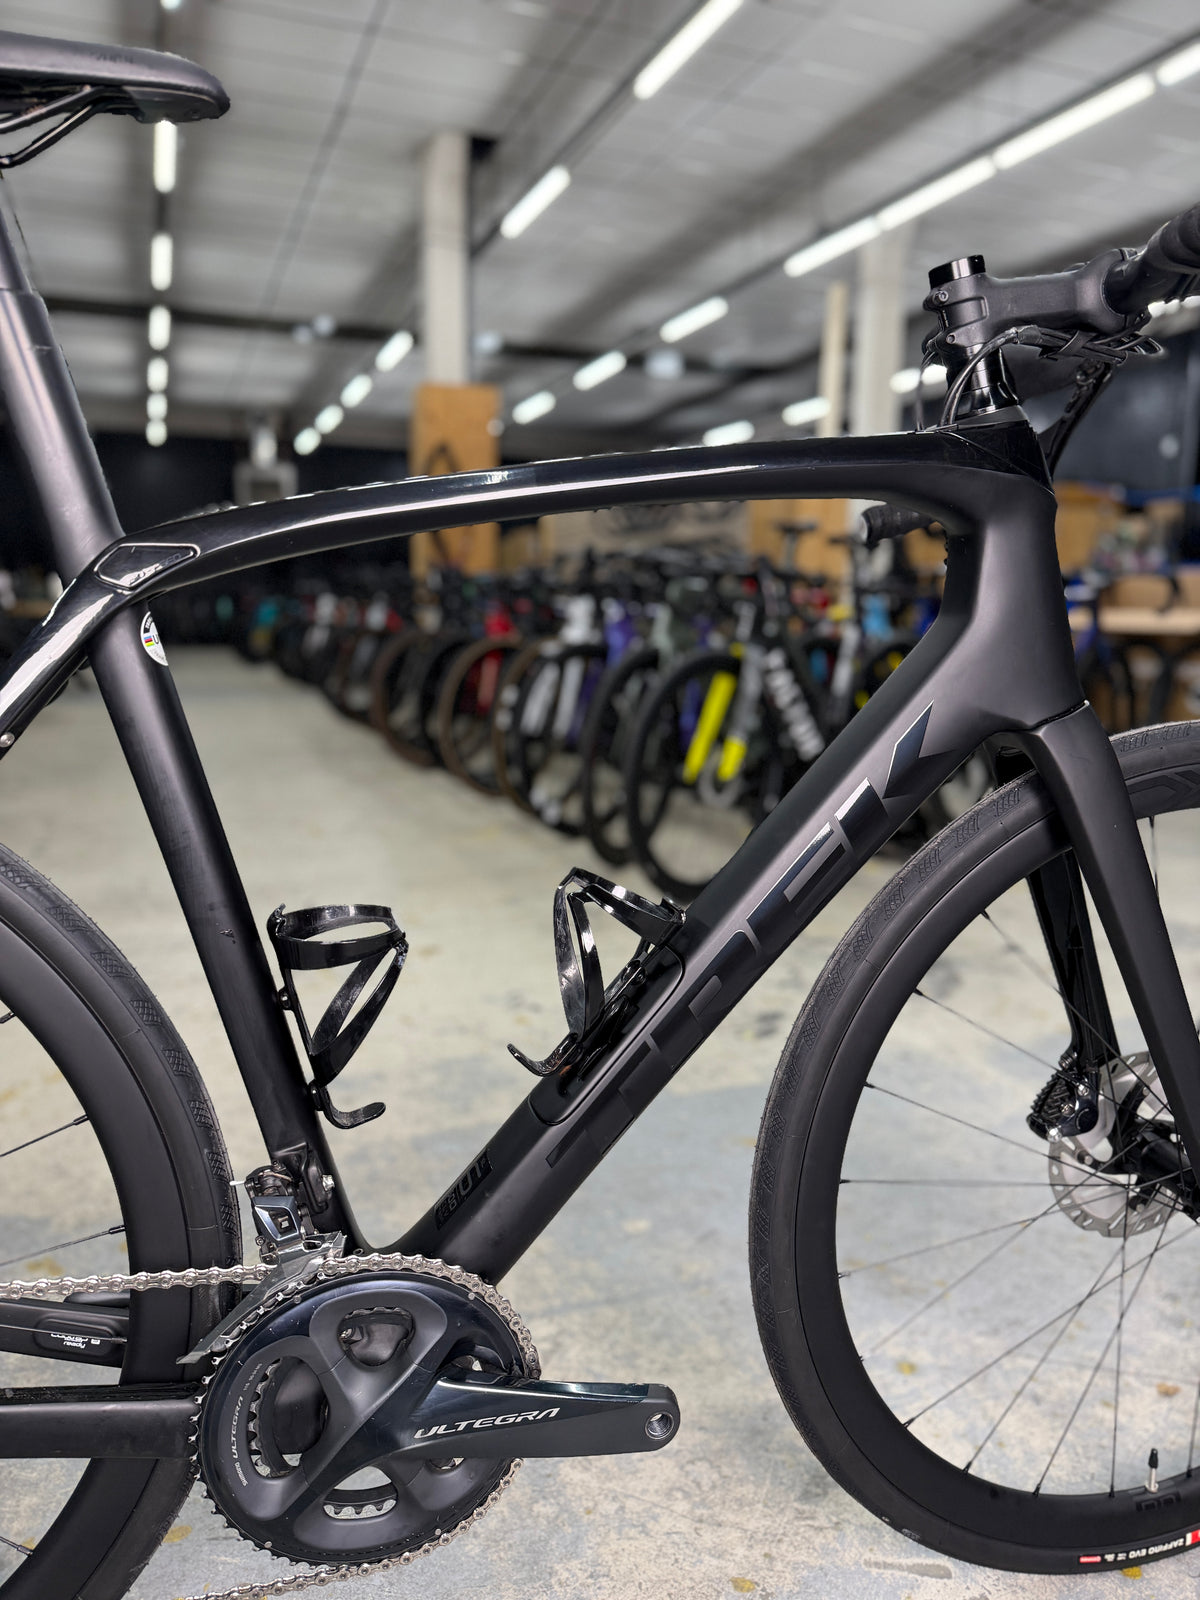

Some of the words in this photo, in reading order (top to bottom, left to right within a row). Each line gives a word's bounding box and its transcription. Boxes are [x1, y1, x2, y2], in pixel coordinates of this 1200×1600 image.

[230, 1396, 244, 1459] ULTEGRA
[413, 1407, 561, 1439] ULTEGRA
[1128, 1548, 1148, 1559] EVO
